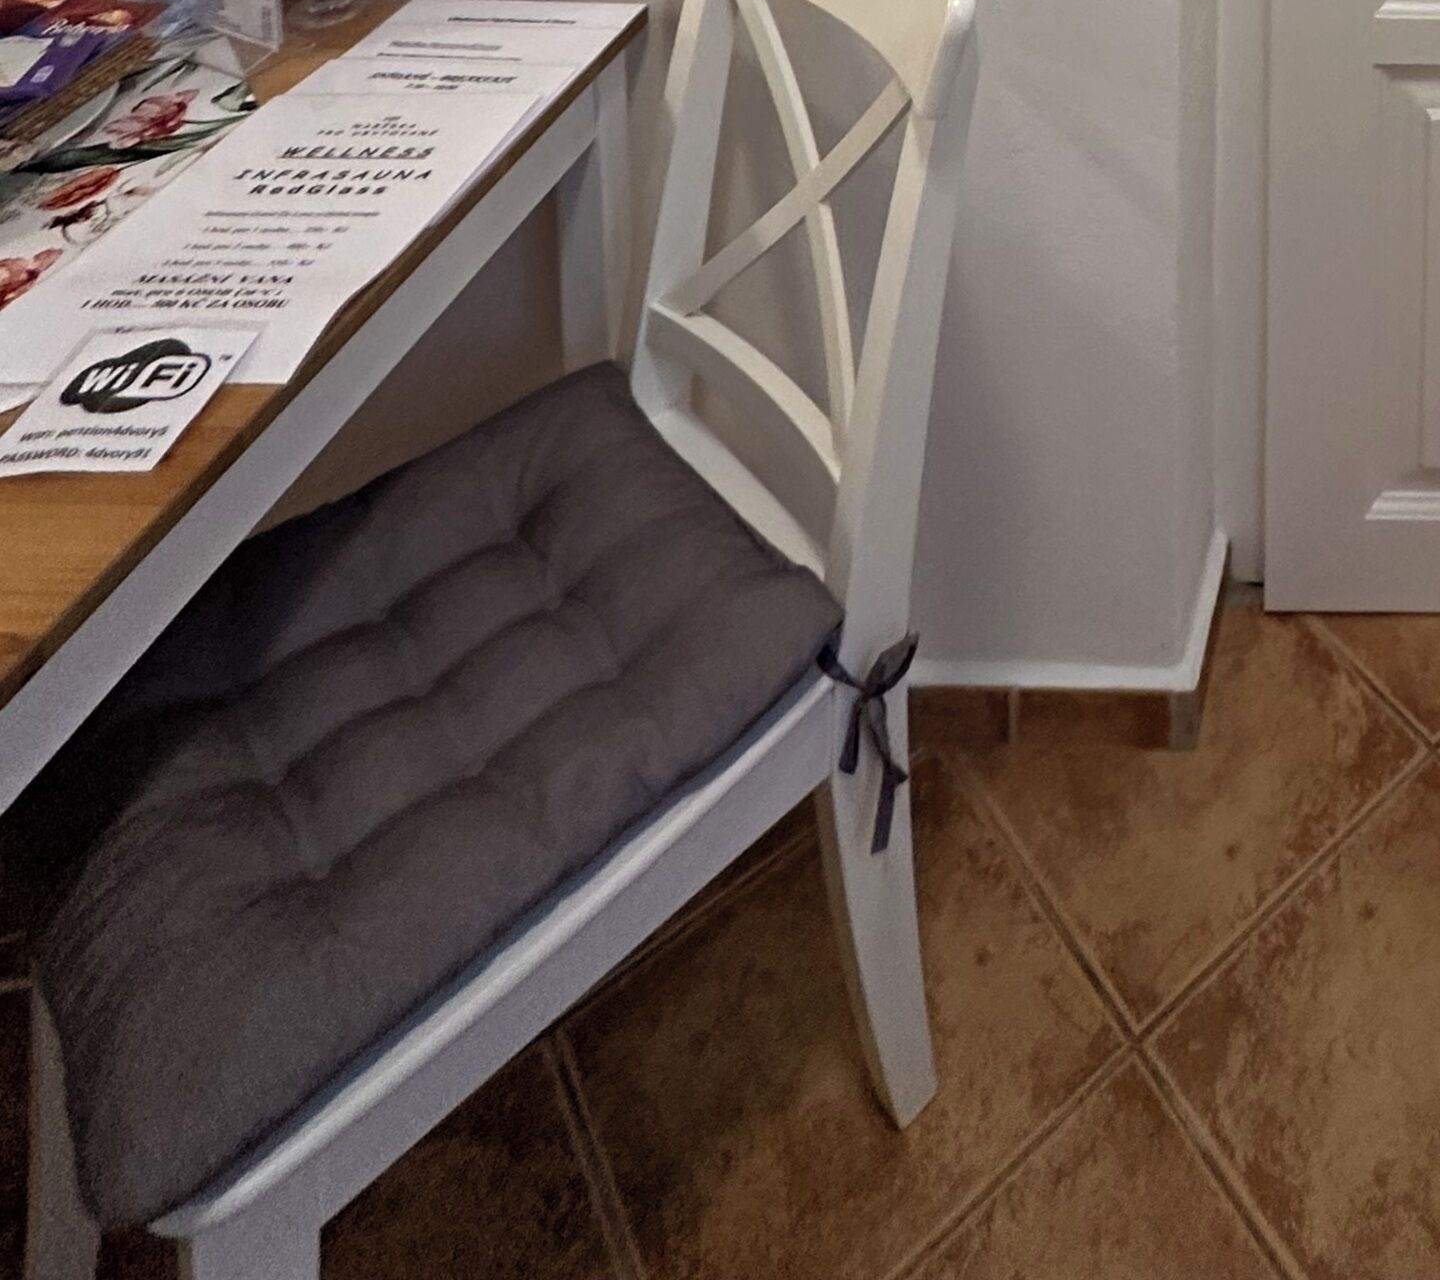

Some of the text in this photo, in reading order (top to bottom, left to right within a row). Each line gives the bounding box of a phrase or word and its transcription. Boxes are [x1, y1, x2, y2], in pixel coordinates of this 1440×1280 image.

[281, 145, 436, 159] WELLNESS
[233, 168, 433, 181] INFRASAUNA
[248, 184, 388, 196] RedGlass
